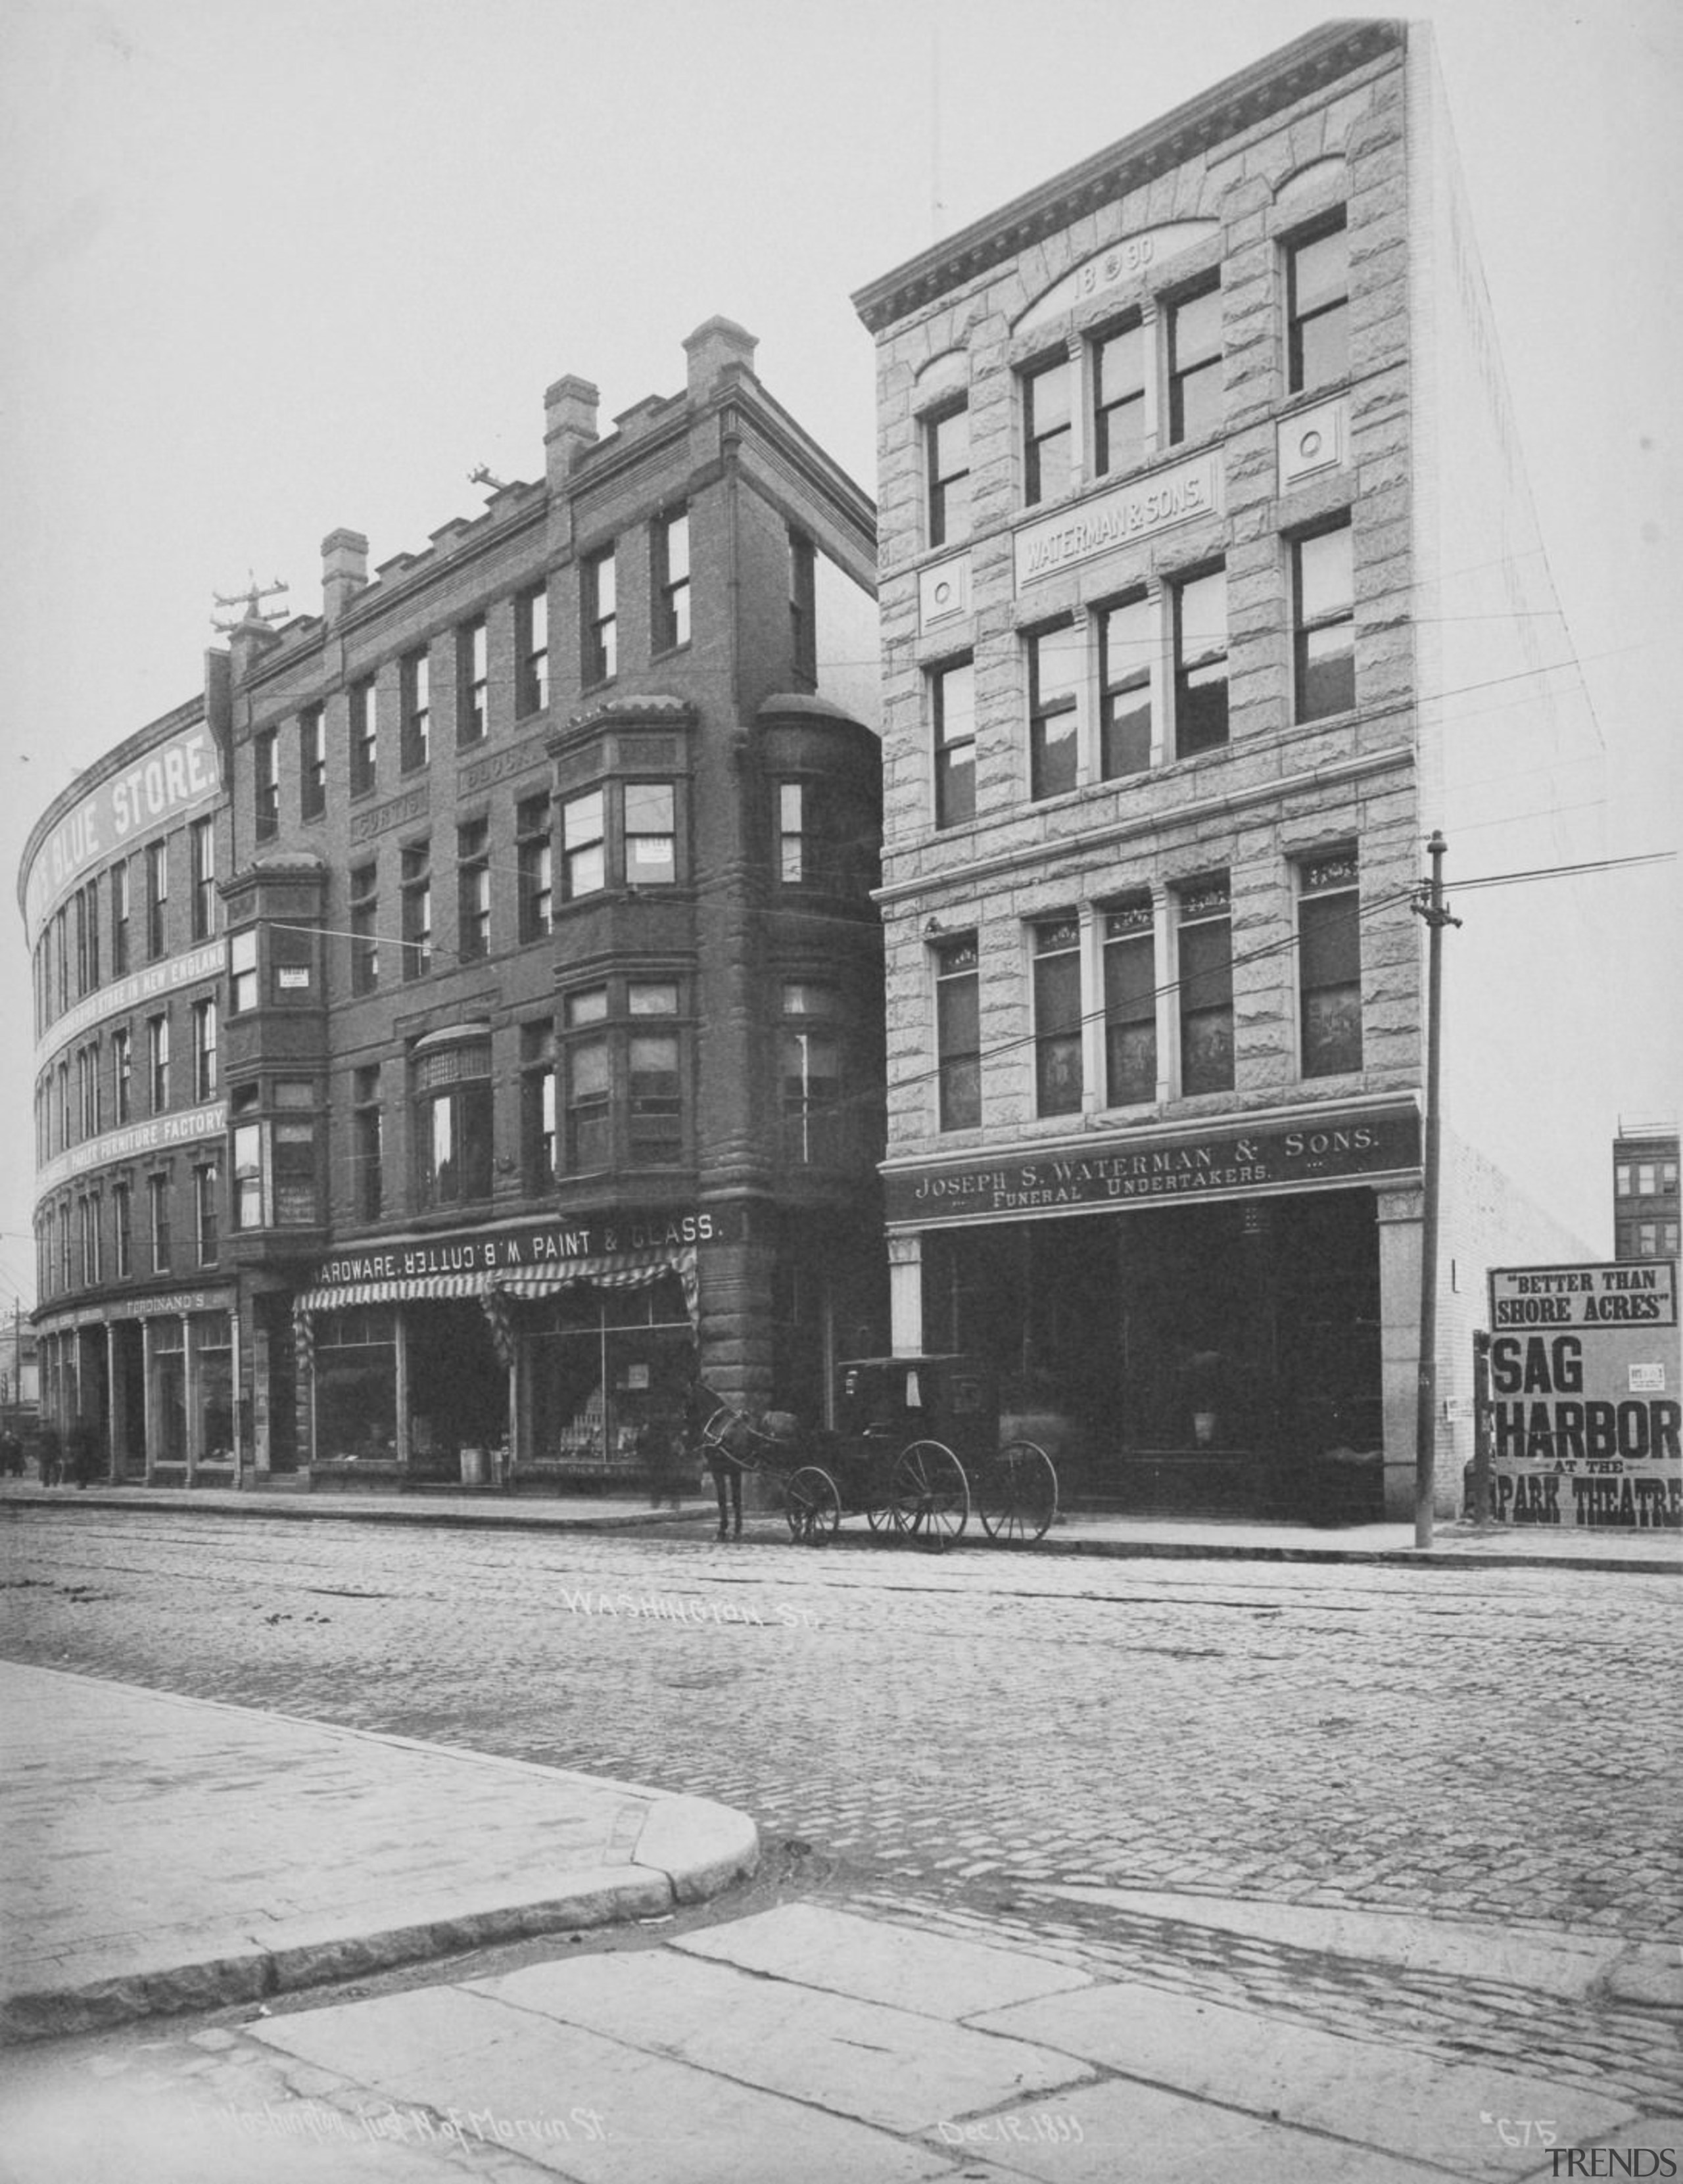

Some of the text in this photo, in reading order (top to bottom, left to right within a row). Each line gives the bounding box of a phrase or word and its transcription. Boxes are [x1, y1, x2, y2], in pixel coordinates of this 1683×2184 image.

[1027, 505, 1127, 573] WATERMAN
[112, 734, 217, 836] STORE.
[164, 1108, 227, 1140] FACTORY.
[915, 1128, 1381, 1199] JOSEPH S. WATERMAN & SONS.
[993, 1165, 1272, 1208] FUNERAL UNDERTAKERS.
[533, 1231, 590, 1259] PAINT
[1602, 1270, 1656, 1291] THAN
[126, 1293, 205, 1316] FERDINAND'S
[1498, 1297, 1571, 1324] SHORE
[1492, 1335, 1583, 1394] SAG
[1495, 1400, 1682, 1459] HARBOR
[1553, 1460, 1624, 1474] AT THE
[1497, 1475, 1683, 1527] PARK THEATRE
